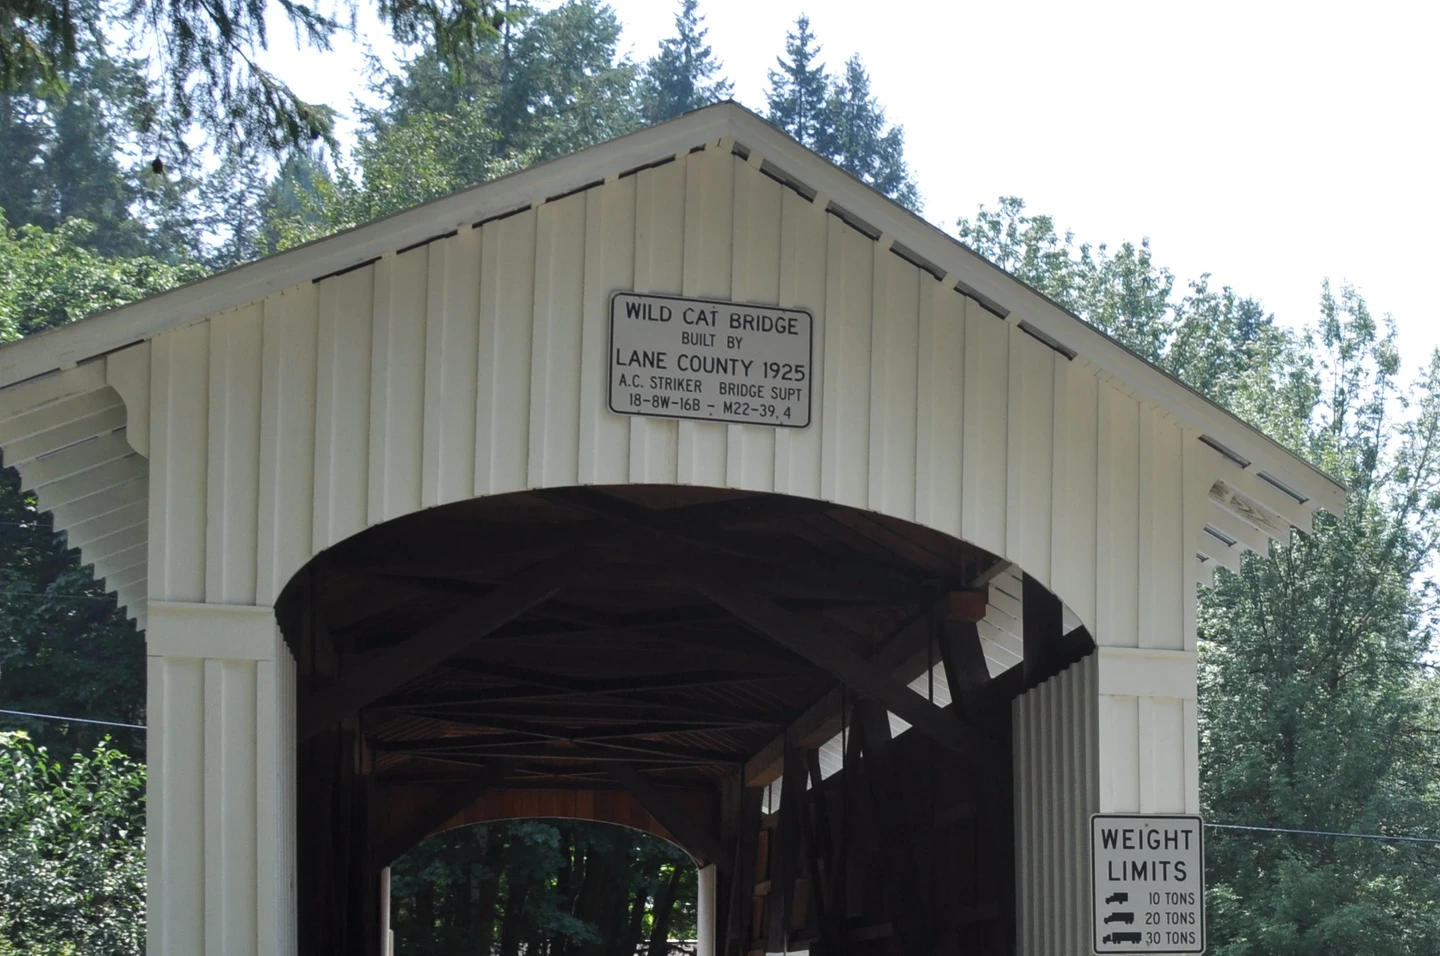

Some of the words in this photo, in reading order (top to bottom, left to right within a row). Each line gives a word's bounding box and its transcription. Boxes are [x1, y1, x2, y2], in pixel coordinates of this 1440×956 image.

[626, 301, 672, 322] WILD
[683, 307, 718, 327] CAT
[729, 313, 799, 335] BRIDGE
[682, 331, 716, 347] BUILT
[727, 335, 743, 350] BY
[616, 348, 667, 369] LANE
[677, 354, 753, 377] COUNTY
[763, 361, 805, 382] 1925
[619, 373, 644, 389] A.C.
[650, 376, 702, 393] STRIKER
[719, 382, 764, 399] BRIDGE
[771, 386, 802, 402] SUPT
[1101, 829, 1193, 850] WEIGHT
[1108, 860, 1187, 881] LIMITS
[1149, 892, 1160, 905] 10
[1165, 892, 1195, 905] TONS
[1145, 912, 1160, 925] 20
[1165, 912, 1195, 925] TONS
[1146, 932, 1161, 944] 30
[1165, 932, 1196, 944] TONS
